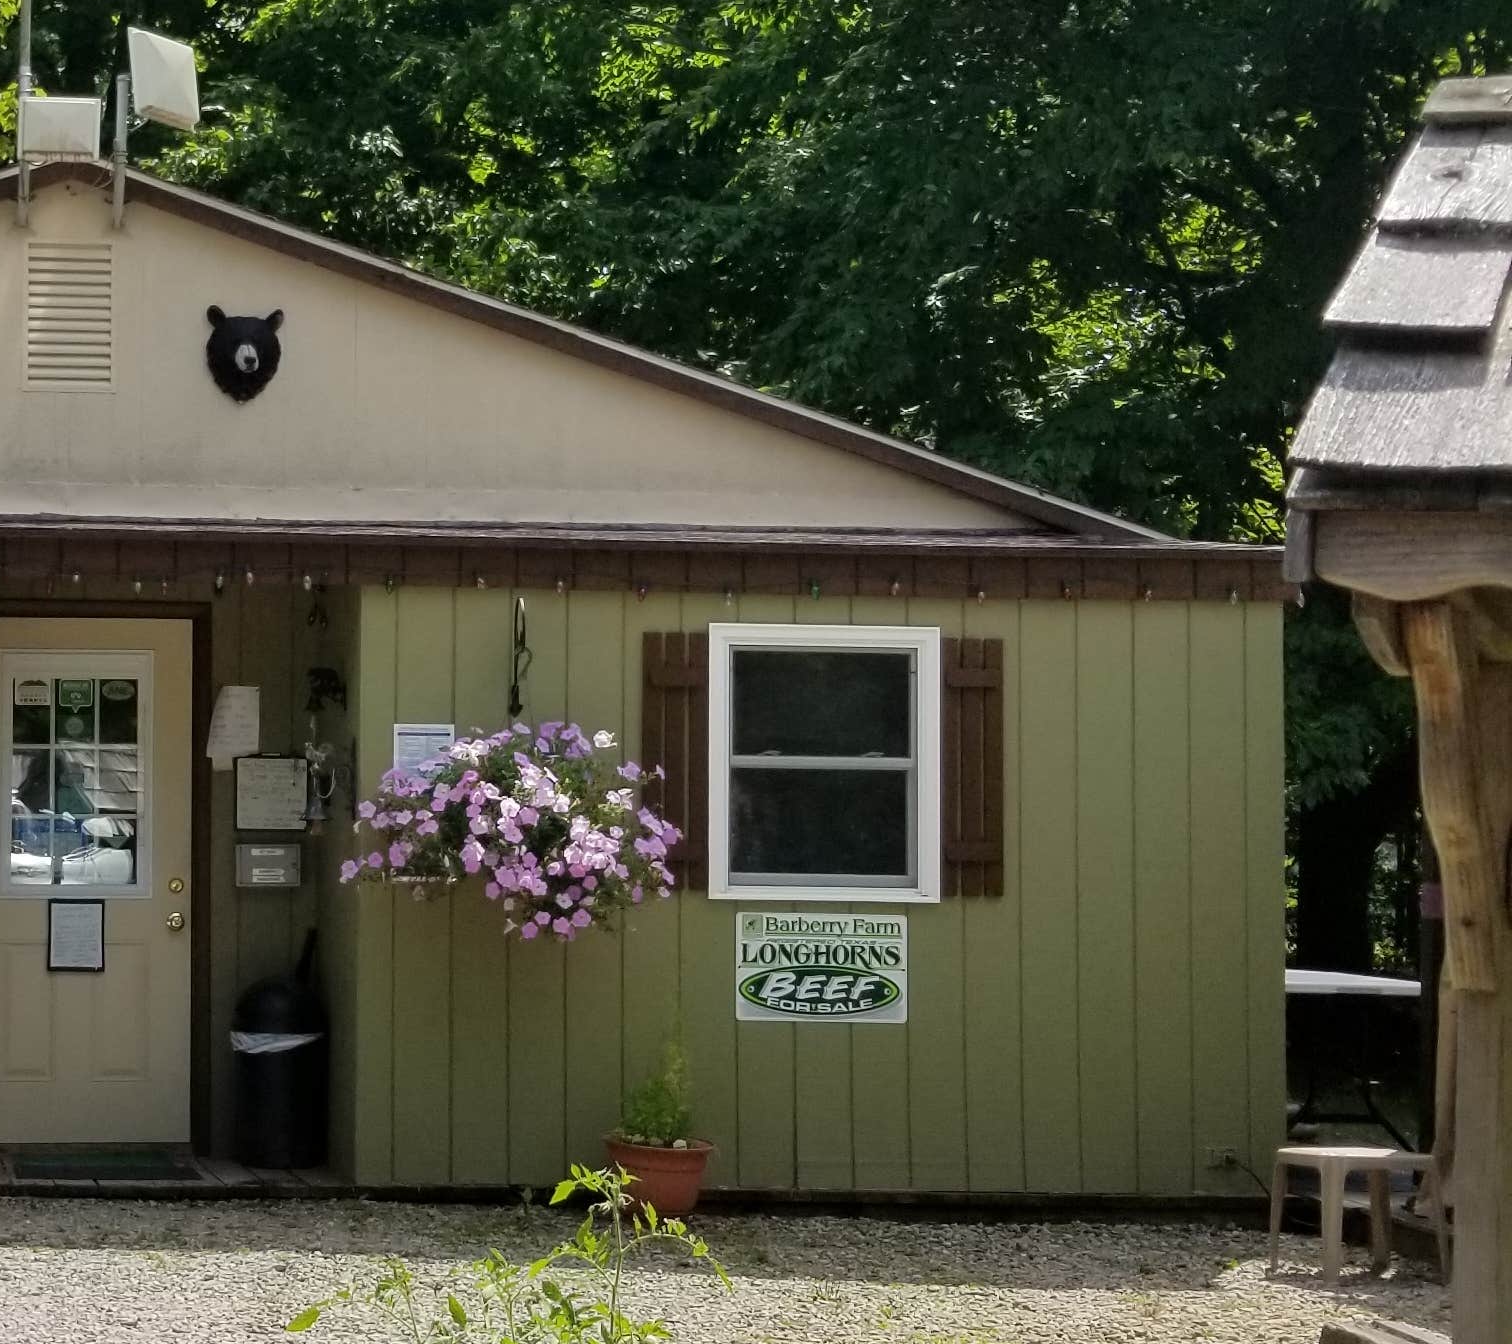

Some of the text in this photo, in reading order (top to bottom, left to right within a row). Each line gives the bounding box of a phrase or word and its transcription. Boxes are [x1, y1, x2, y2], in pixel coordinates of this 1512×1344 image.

[765, 916, 901, 937] Barberry Farm
[741, 943, 901, 969] LONGHORNS
[758, 971, 880, 1000] BEEF
[767, 997, 874, 1013] FOR SALE
